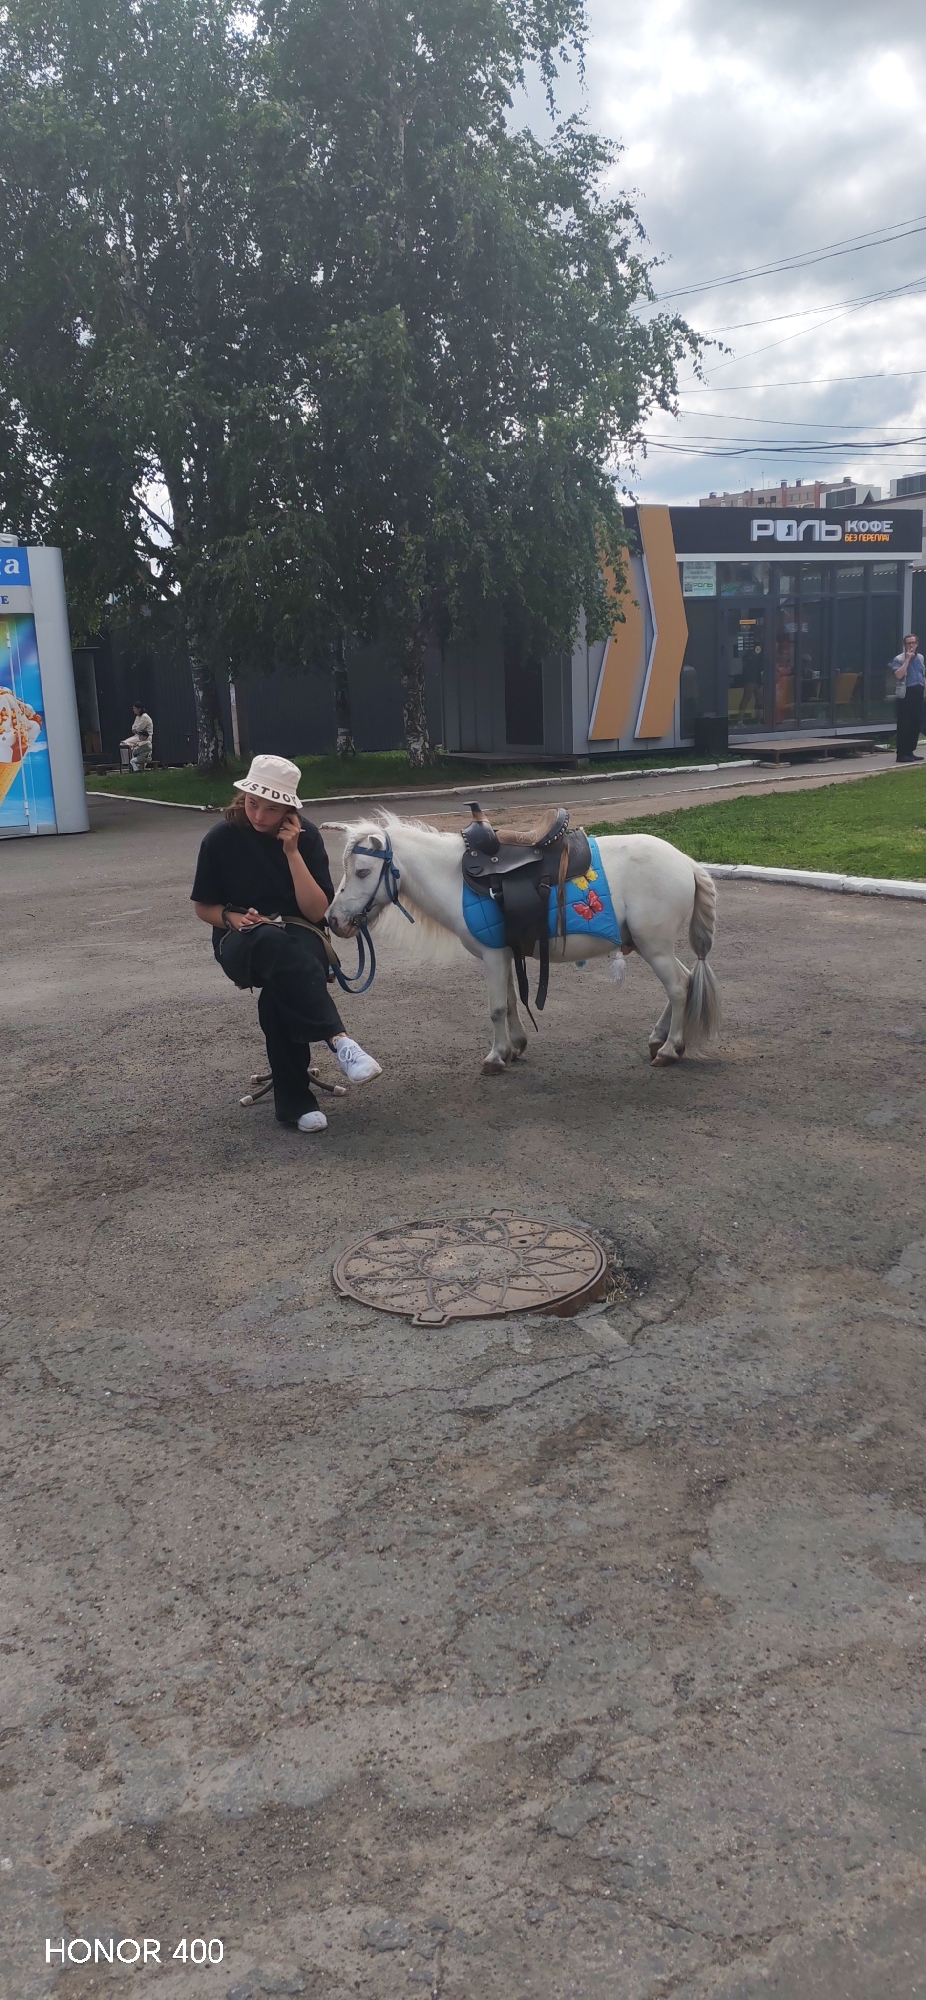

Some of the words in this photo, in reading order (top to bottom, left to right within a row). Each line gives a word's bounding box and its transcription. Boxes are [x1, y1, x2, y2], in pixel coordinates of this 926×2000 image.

[750, 519, 842, 542] РОЛЬ
[845, 520, 894, 533] КОФЕ
[844, 533, 858, 542] БЕЗ
